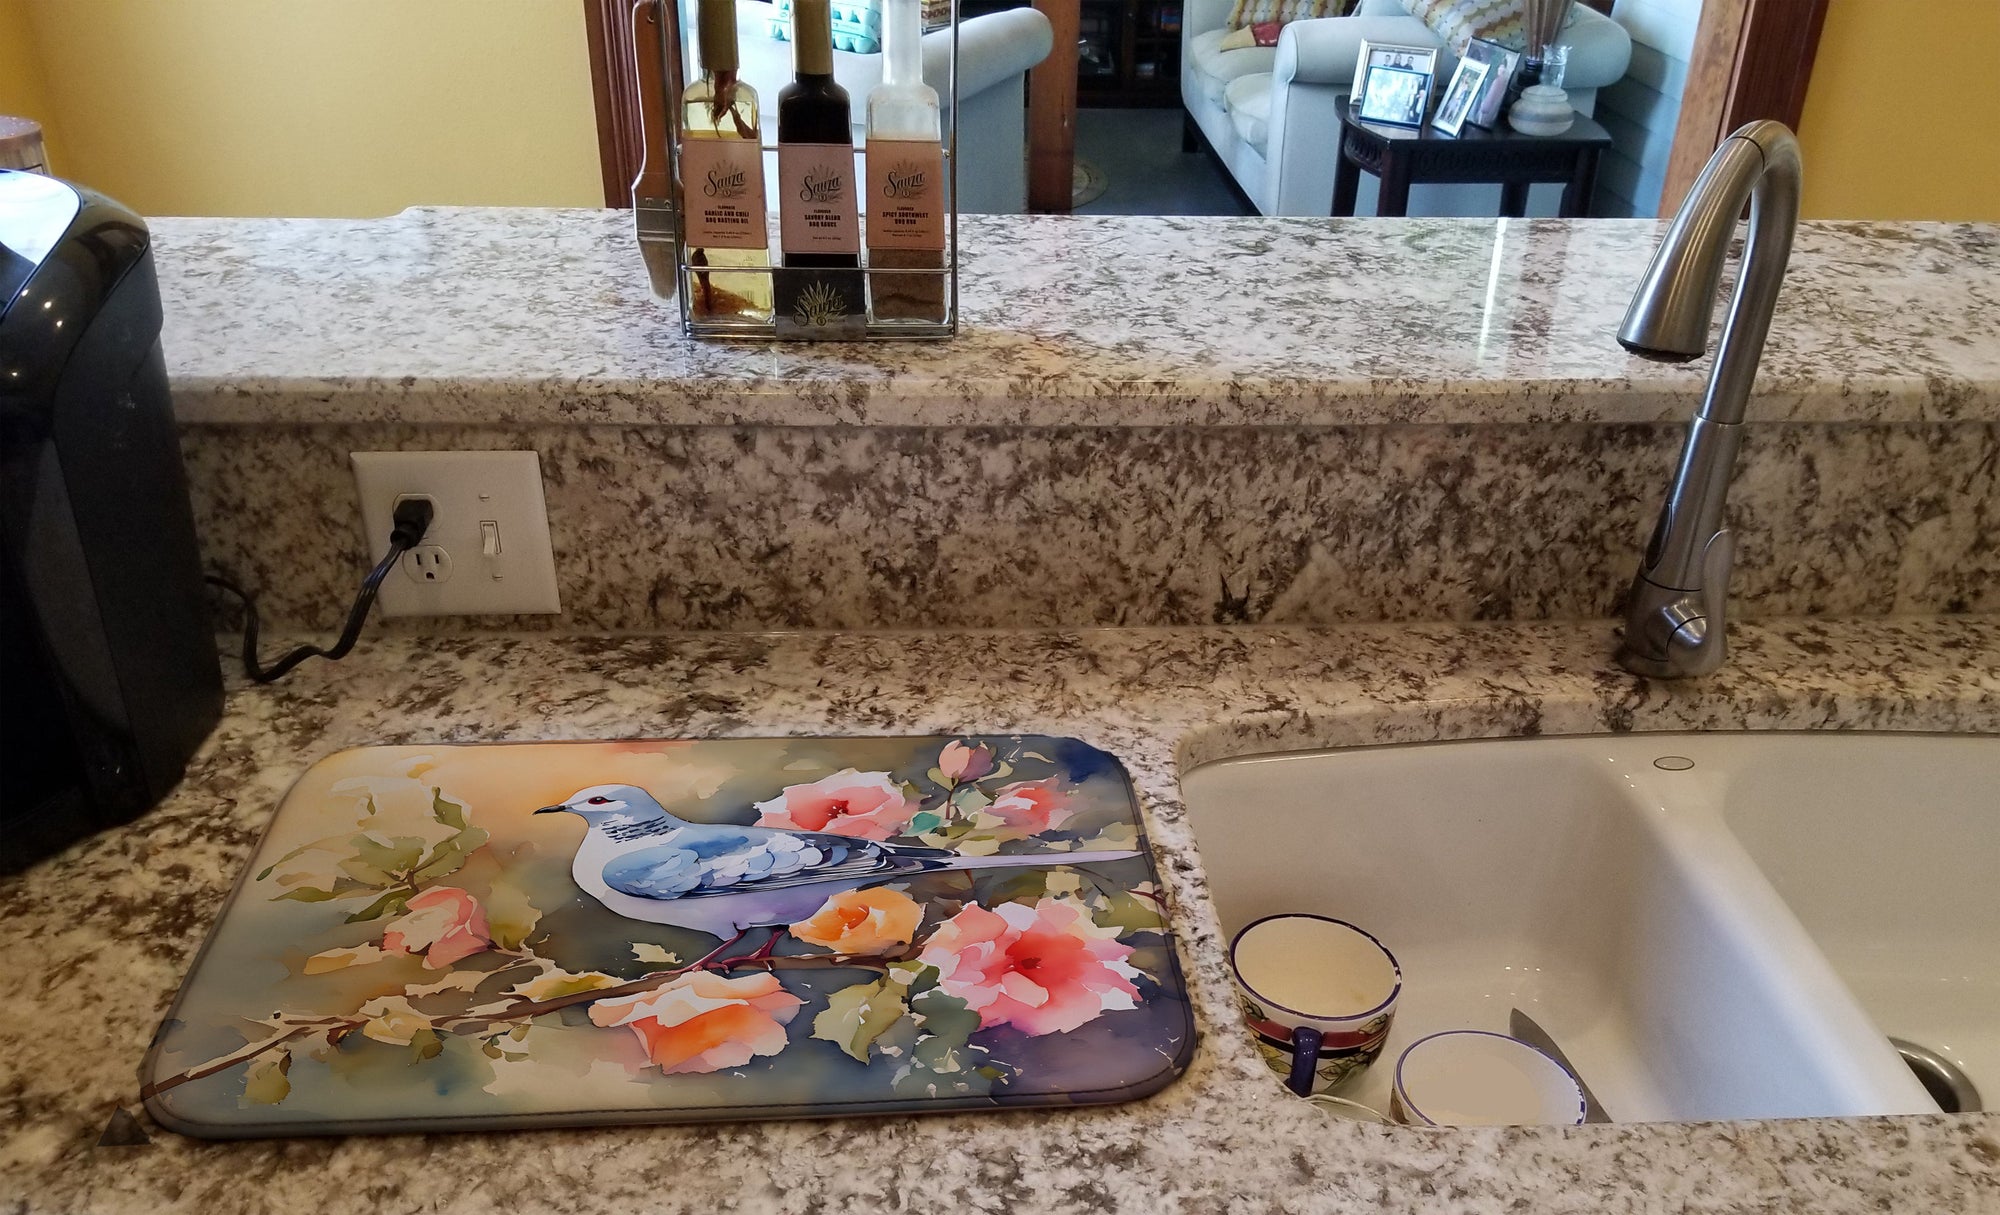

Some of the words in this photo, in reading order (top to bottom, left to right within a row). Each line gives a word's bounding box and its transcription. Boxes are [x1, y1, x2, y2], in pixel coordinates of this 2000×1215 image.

[704, 170, 746, 197] Sauza
[800, 176, 841, 202] Sauza
[884, 171, 925, 198] Sauza
